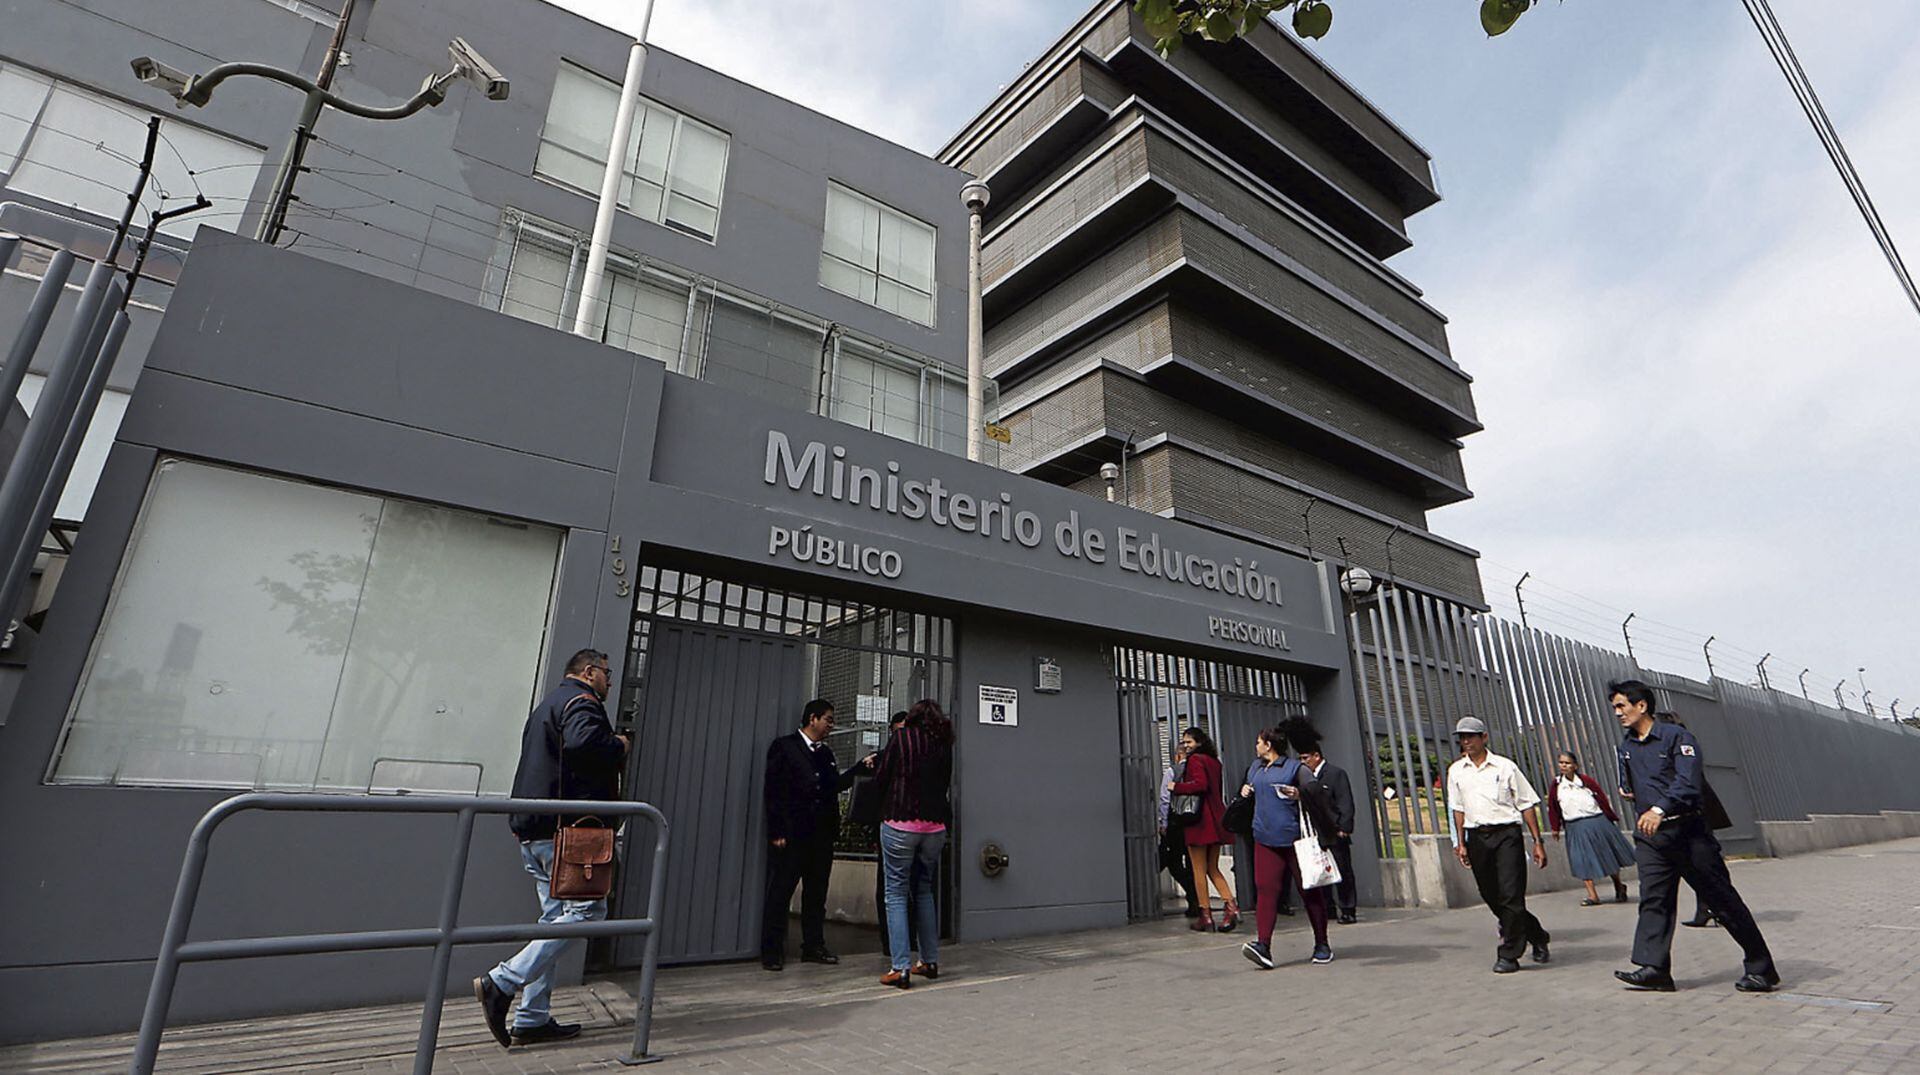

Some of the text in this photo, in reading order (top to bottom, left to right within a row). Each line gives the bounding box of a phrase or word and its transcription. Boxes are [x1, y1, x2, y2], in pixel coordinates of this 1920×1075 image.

[765, 430, 1283, 605] Ministerio de Educación
[611, 535, 630, 597] 193
[769, 524, 902, 578] PÚBLICO
[1208, 615, 1291, 651] PERSONAL
